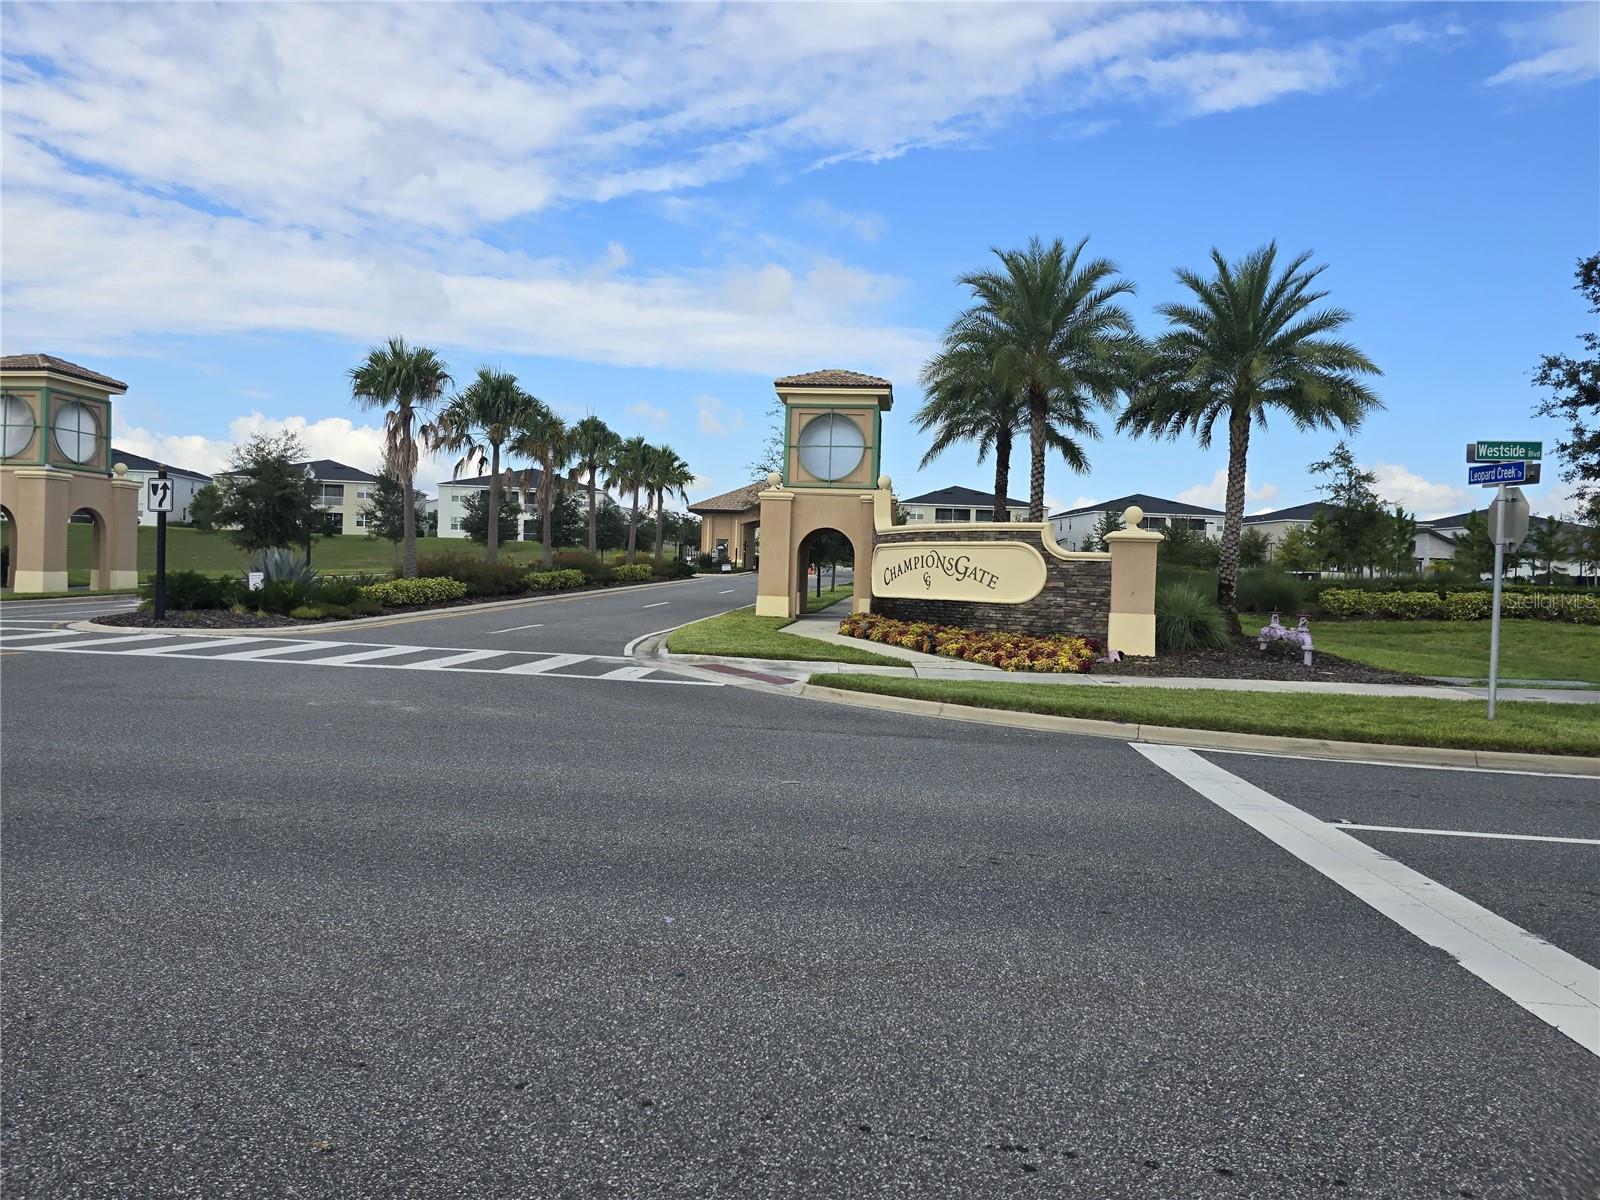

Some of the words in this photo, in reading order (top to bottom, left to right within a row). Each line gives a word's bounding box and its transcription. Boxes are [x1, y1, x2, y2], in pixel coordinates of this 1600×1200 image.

[1478, 444, 1525, 457] Westside
[1470, 468, 1496, 482] Leopard
[1497, 466, 1516, 479] Creek
